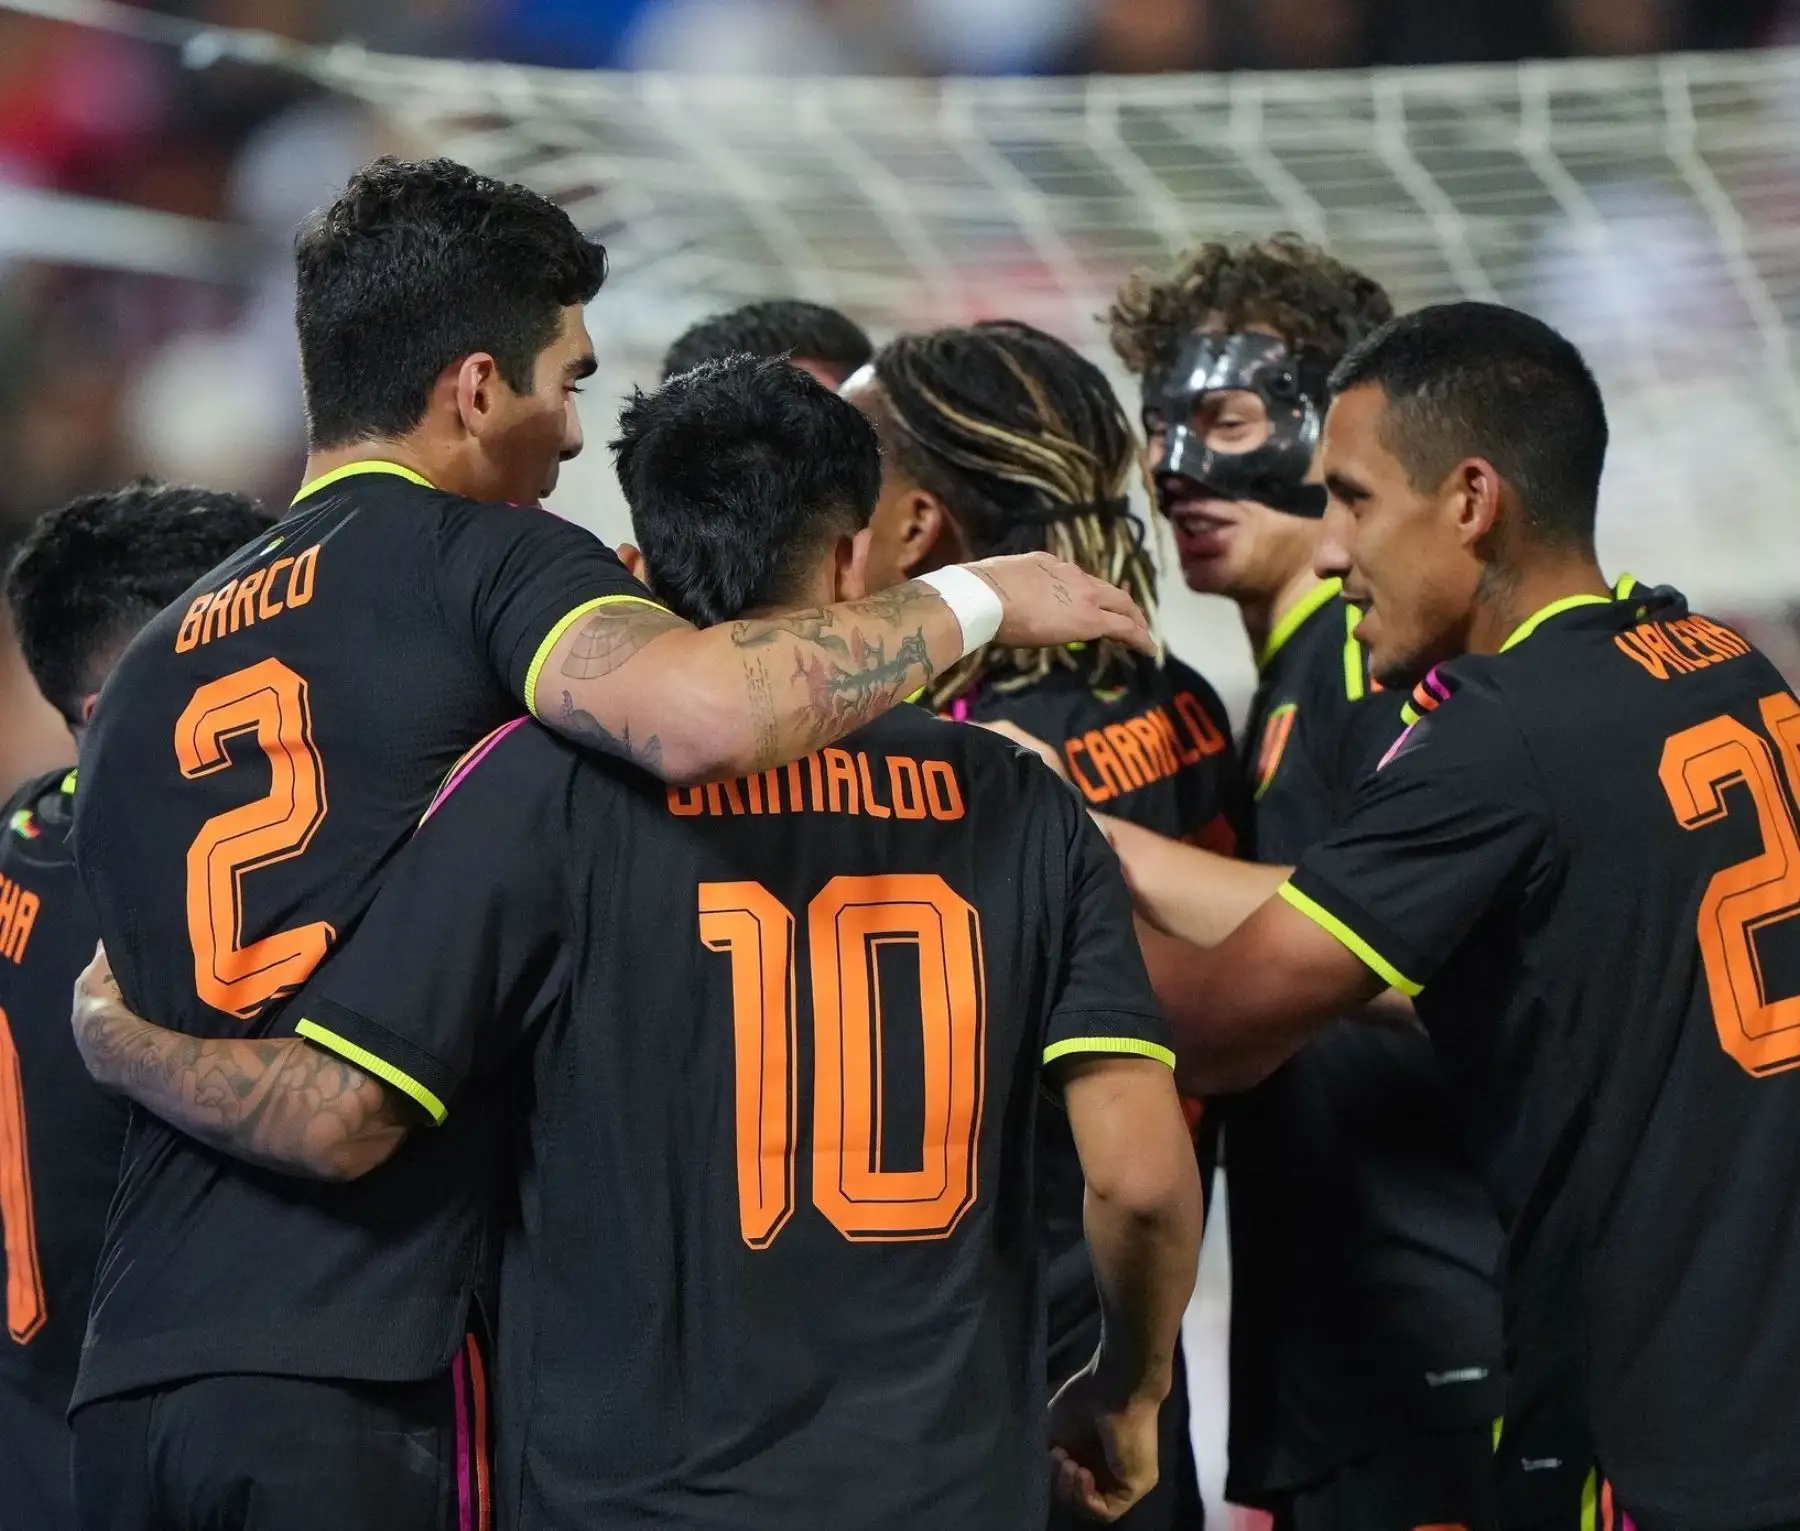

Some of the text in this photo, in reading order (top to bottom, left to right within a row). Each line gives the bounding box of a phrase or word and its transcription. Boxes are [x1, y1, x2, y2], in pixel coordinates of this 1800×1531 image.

[175, 544, 321, 654] BARCO
[1614, 615, 1752, 680] VALERA
[174, 657, 336, 1019] 2
[0, 871, 40, 964] HA
[698, 874, 986, 1250] 10
